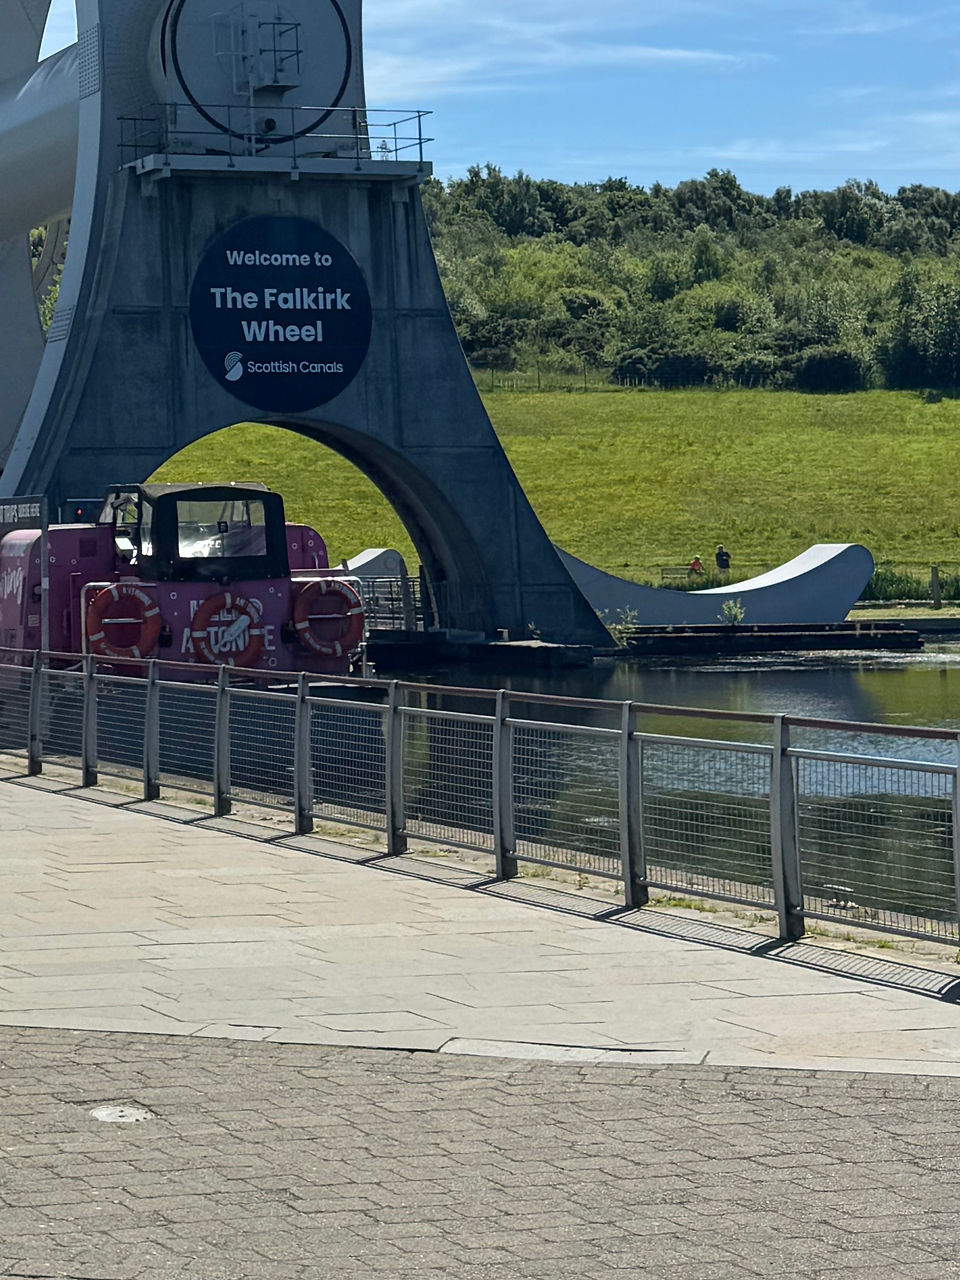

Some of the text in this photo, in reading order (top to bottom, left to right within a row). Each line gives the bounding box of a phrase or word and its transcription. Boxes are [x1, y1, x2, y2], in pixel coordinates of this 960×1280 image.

[226, 250, 333, 266] Welcome to
[210, 286, 352, 310] The Falkirk
[241, 320, 323, 342] Wheel
[247, 360, 344, 373] Scottish Canals
